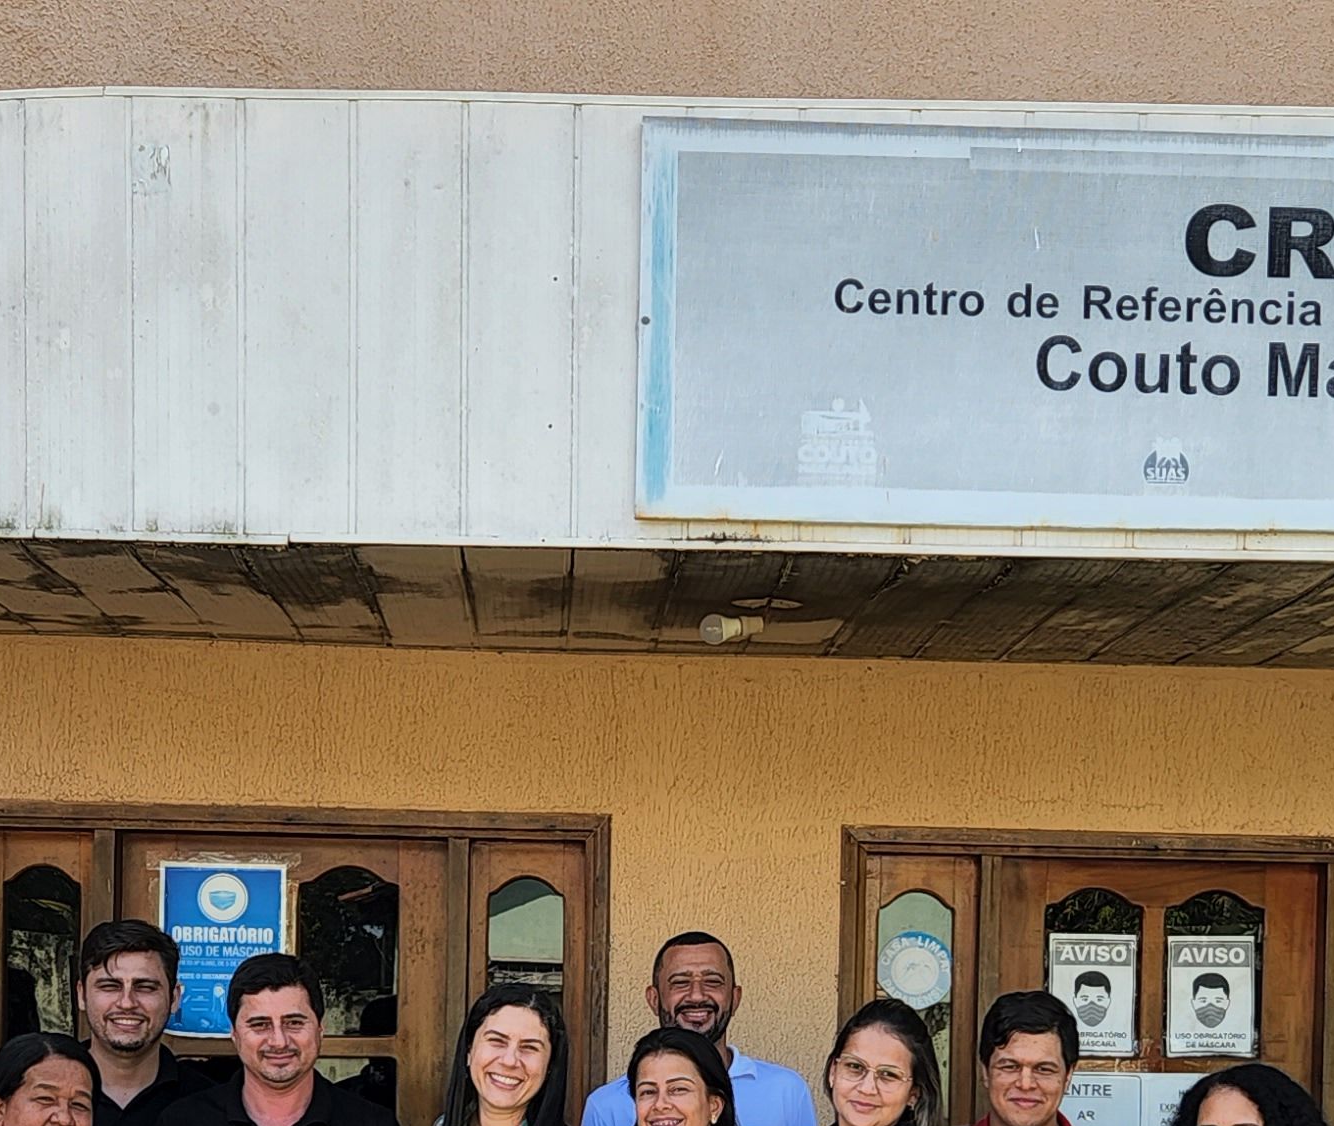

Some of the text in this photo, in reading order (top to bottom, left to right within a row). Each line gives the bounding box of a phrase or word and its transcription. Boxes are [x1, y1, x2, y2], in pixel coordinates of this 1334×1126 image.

[834, 278, 985, 317] Centro
[1007, 283, 1059, 319] de
[1083, 284, 1321, 326] Referência
[1036, 334, 1241, 396] Couto
[1147, 467, 1186, 480] SUAS
[171, 924, 274, 945] OBRIGATÓRIO
[180, 945, 203, 957] USO
[205, 946, 220, 957] DE
[881, 937, 909, 966] CASA
[1060, 945, 1128, 963] AVISO
[1177, 947, 1246, 964] AVISO
[1078, 1030, 1127, 1039] BRIGATÓRIO
[1175, 1031, 1246, 1040] USO OBRIGATÓRIO
[1185, 1040, 1236, 1049] DE MÁSCARA
[1077, 1110, 1095, 1121] AR
